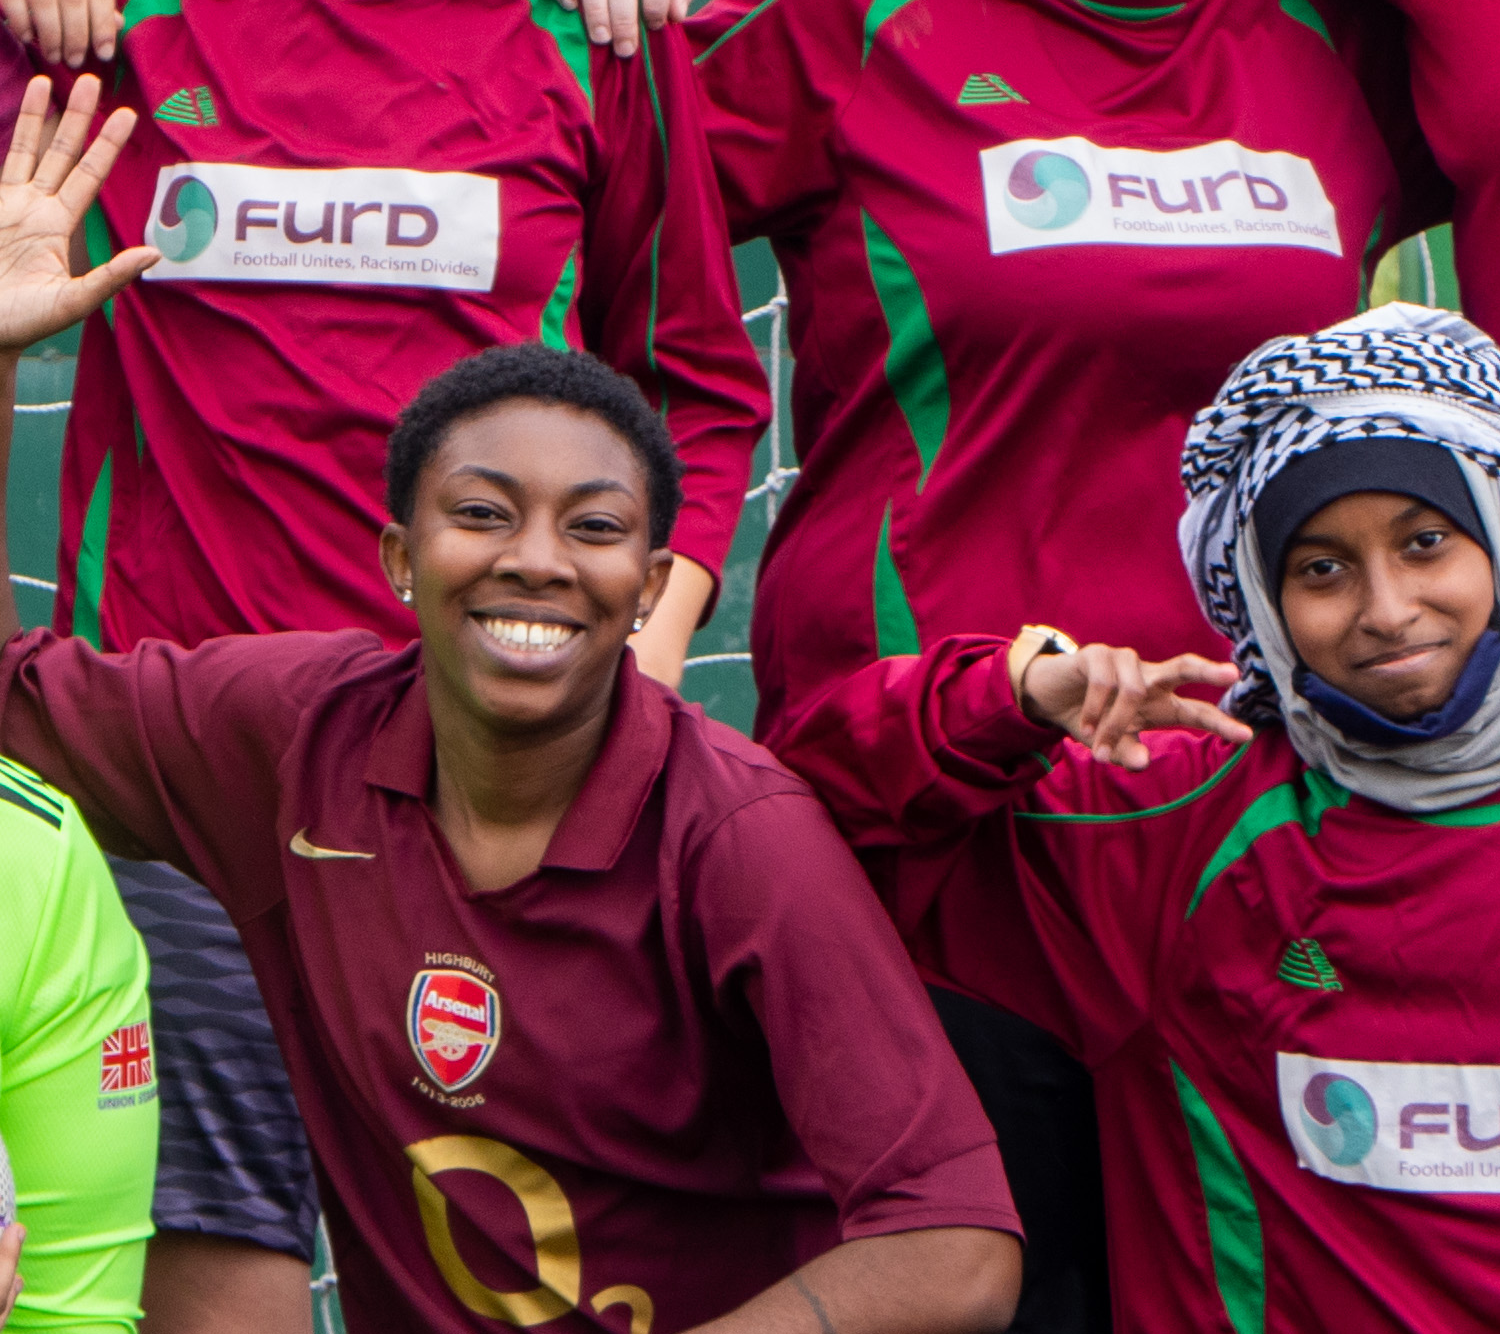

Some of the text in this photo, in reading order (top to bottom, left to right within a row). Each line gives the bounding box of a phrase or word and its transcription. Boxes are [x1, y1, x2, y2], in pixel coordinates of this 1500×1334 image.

[1113, 217, 1332, 240] Football Unites, Racism Divides
[233, 251, 480, 277] Football Unites, Racism Divides
[424, 951, 496, 984] HIGHBURY
[424, 989, 486, 1023] Arsenal
[1399, 1161, 1475, 1178] Football
